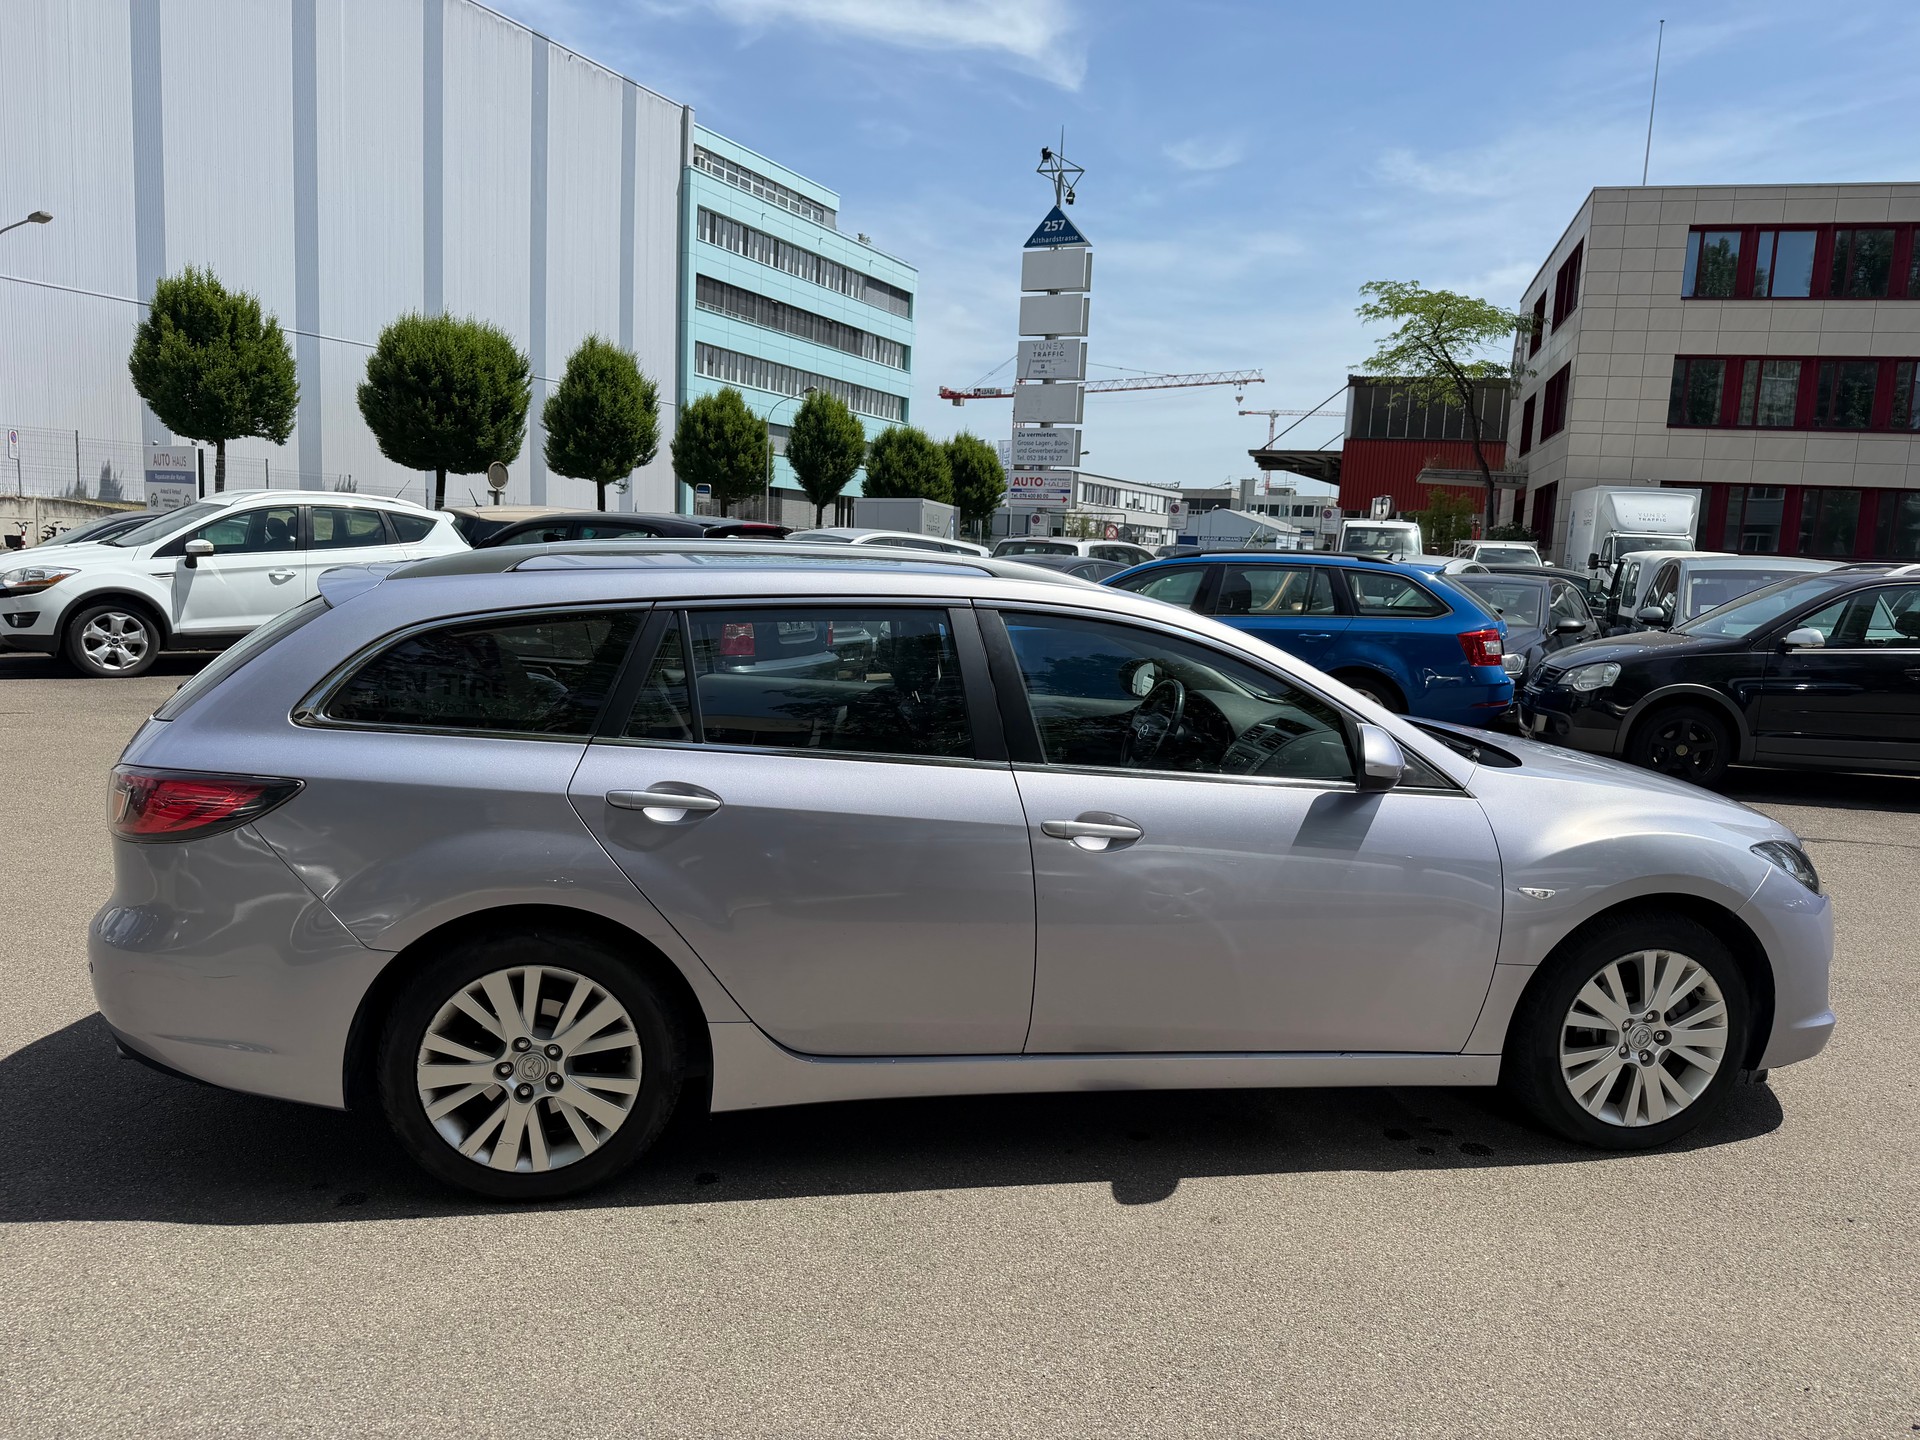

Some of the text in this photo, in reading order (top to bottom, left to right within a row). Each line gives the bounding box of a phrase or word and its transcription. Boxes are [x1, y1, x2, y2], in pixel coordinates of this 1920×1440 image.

[1044, 219, 1066, 232] 257
[1031, 235, 1078, 244] Althardstrasse
[1032, 342, 1065, 351] YUNEX
[1033, 350, 1065, 358] TRAFFIC
[153, 453, 186, 467] AUTO HAUS
[1012, 477, 1043, 486] AUTO
